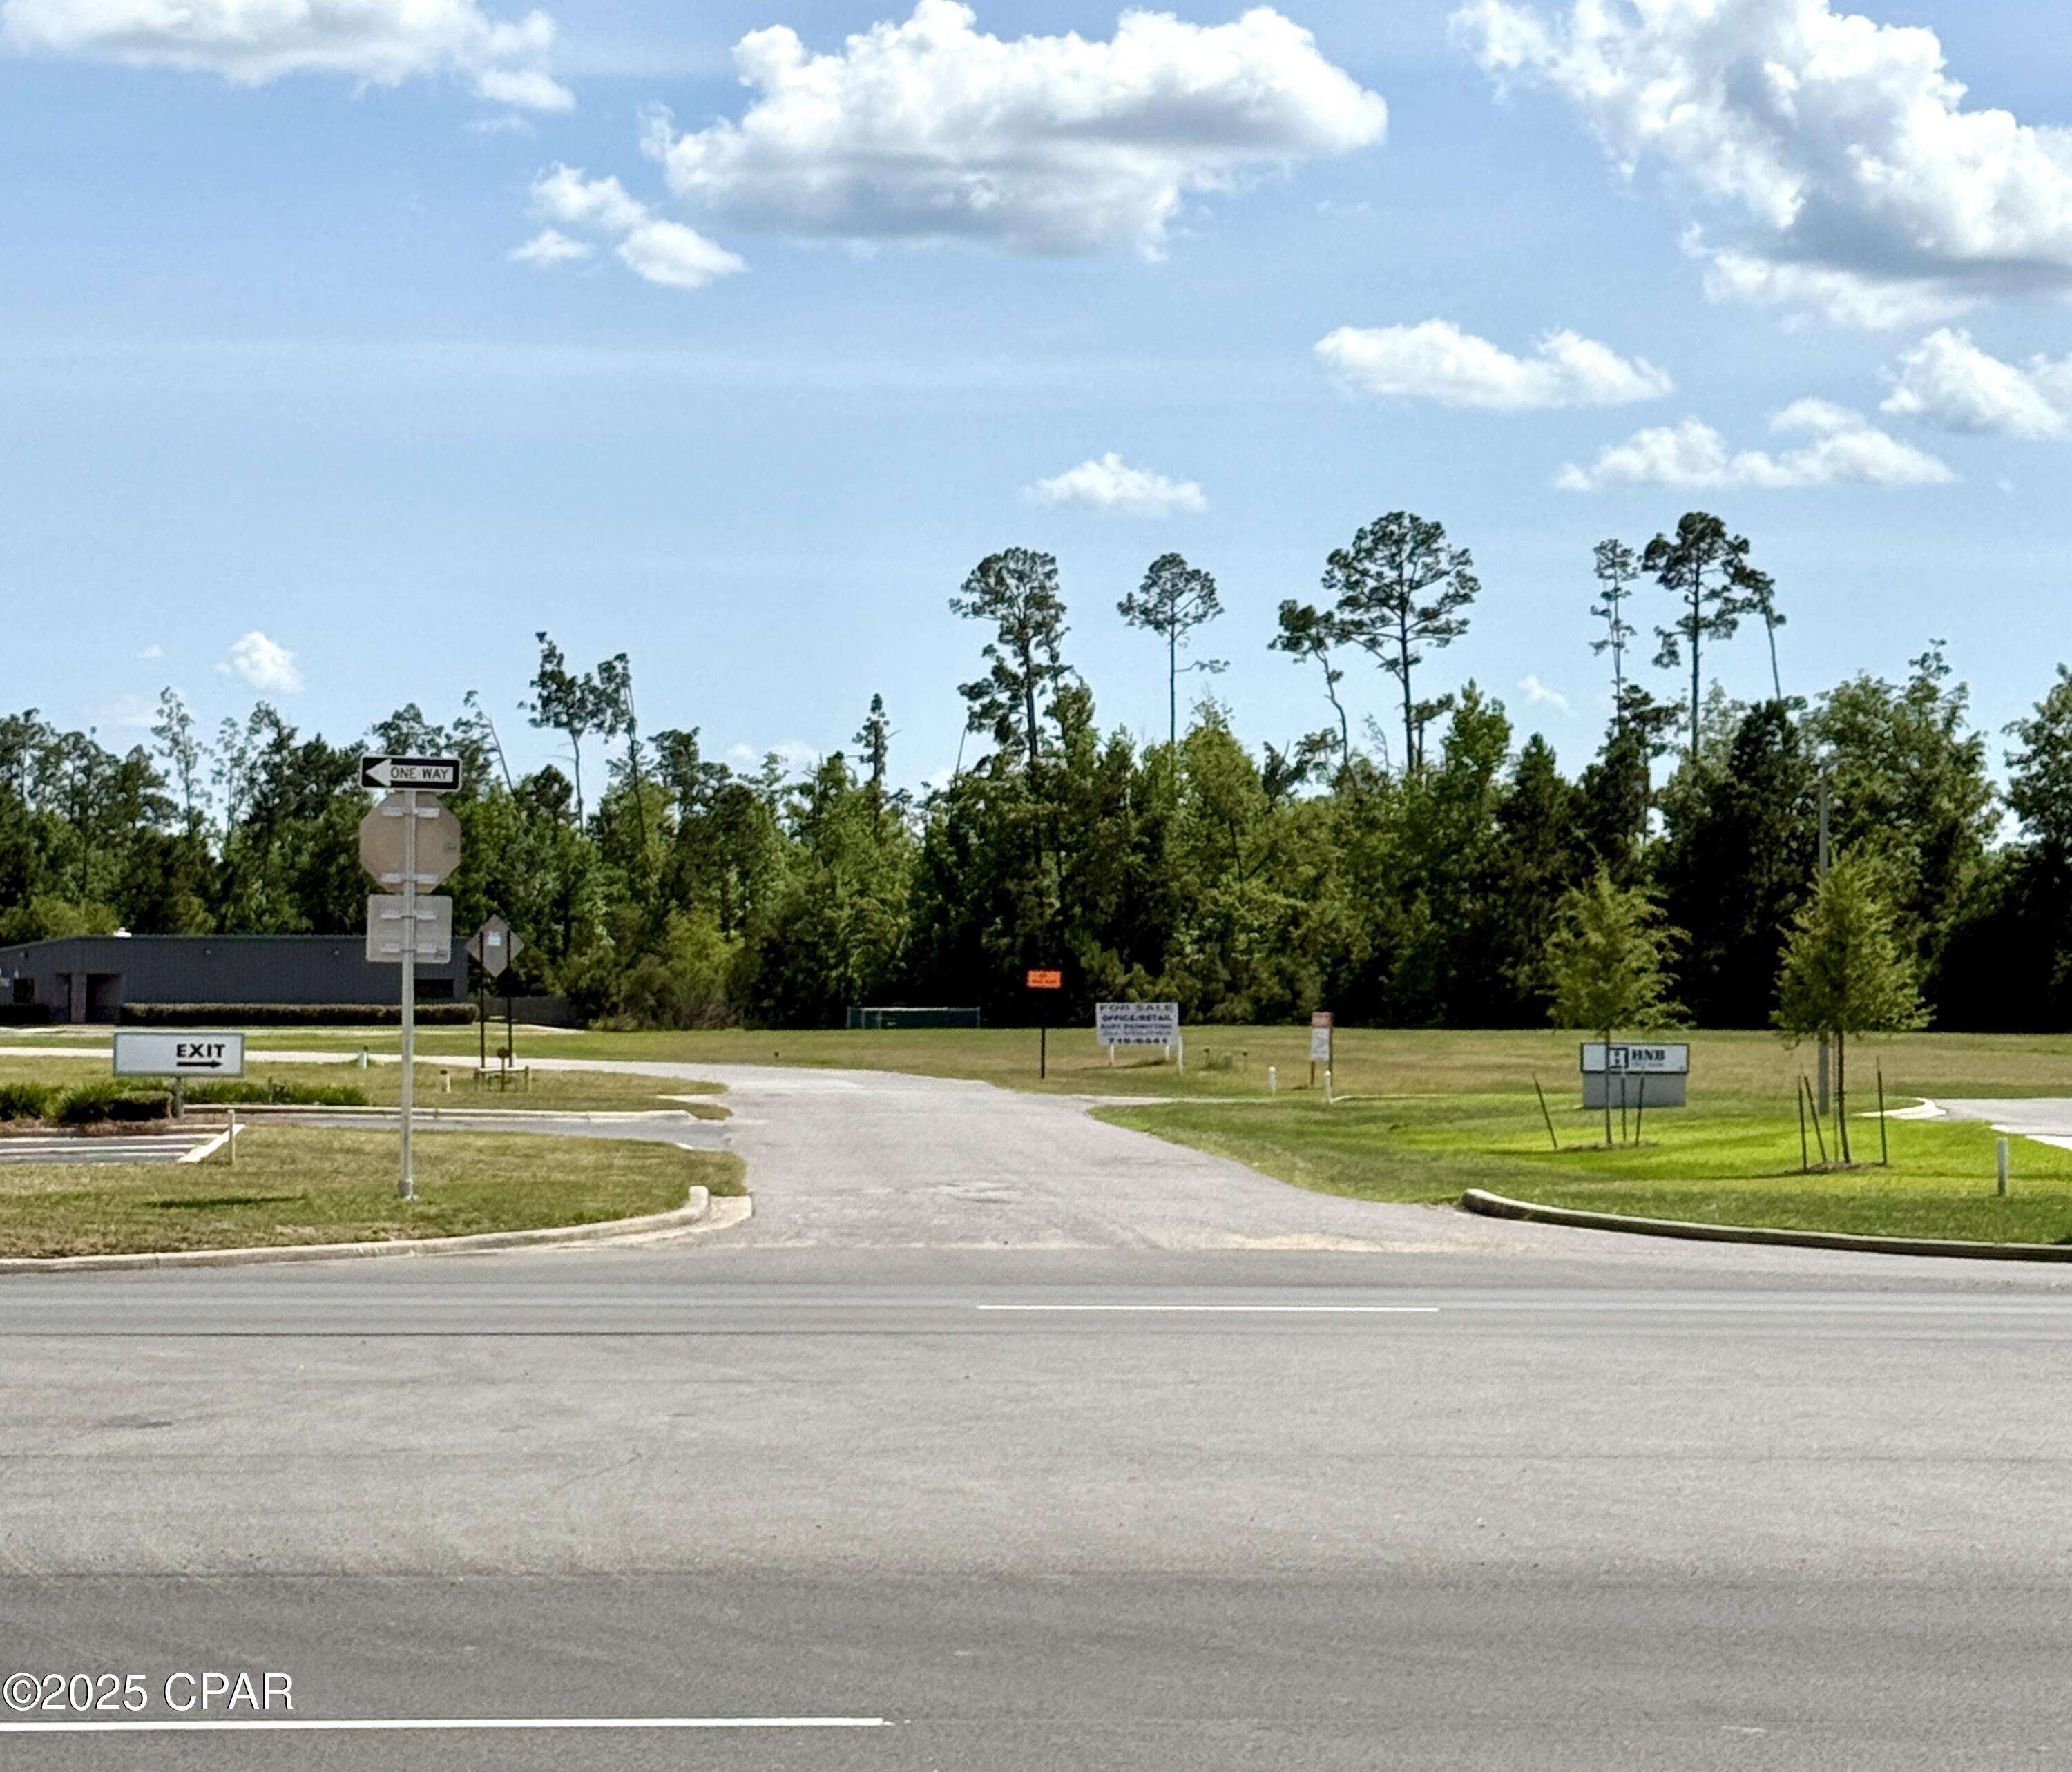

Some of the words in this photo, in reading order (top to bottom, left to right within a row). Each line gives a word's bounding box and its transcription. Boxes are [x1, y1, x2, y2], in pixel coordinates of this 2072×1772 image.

[390, 767, 417, 779] ONE
[422, 767, 449, 780] WAY
[176, 1043, 226, 1058] EXIT
[1631, 1049, 1665, 1061] HNB
